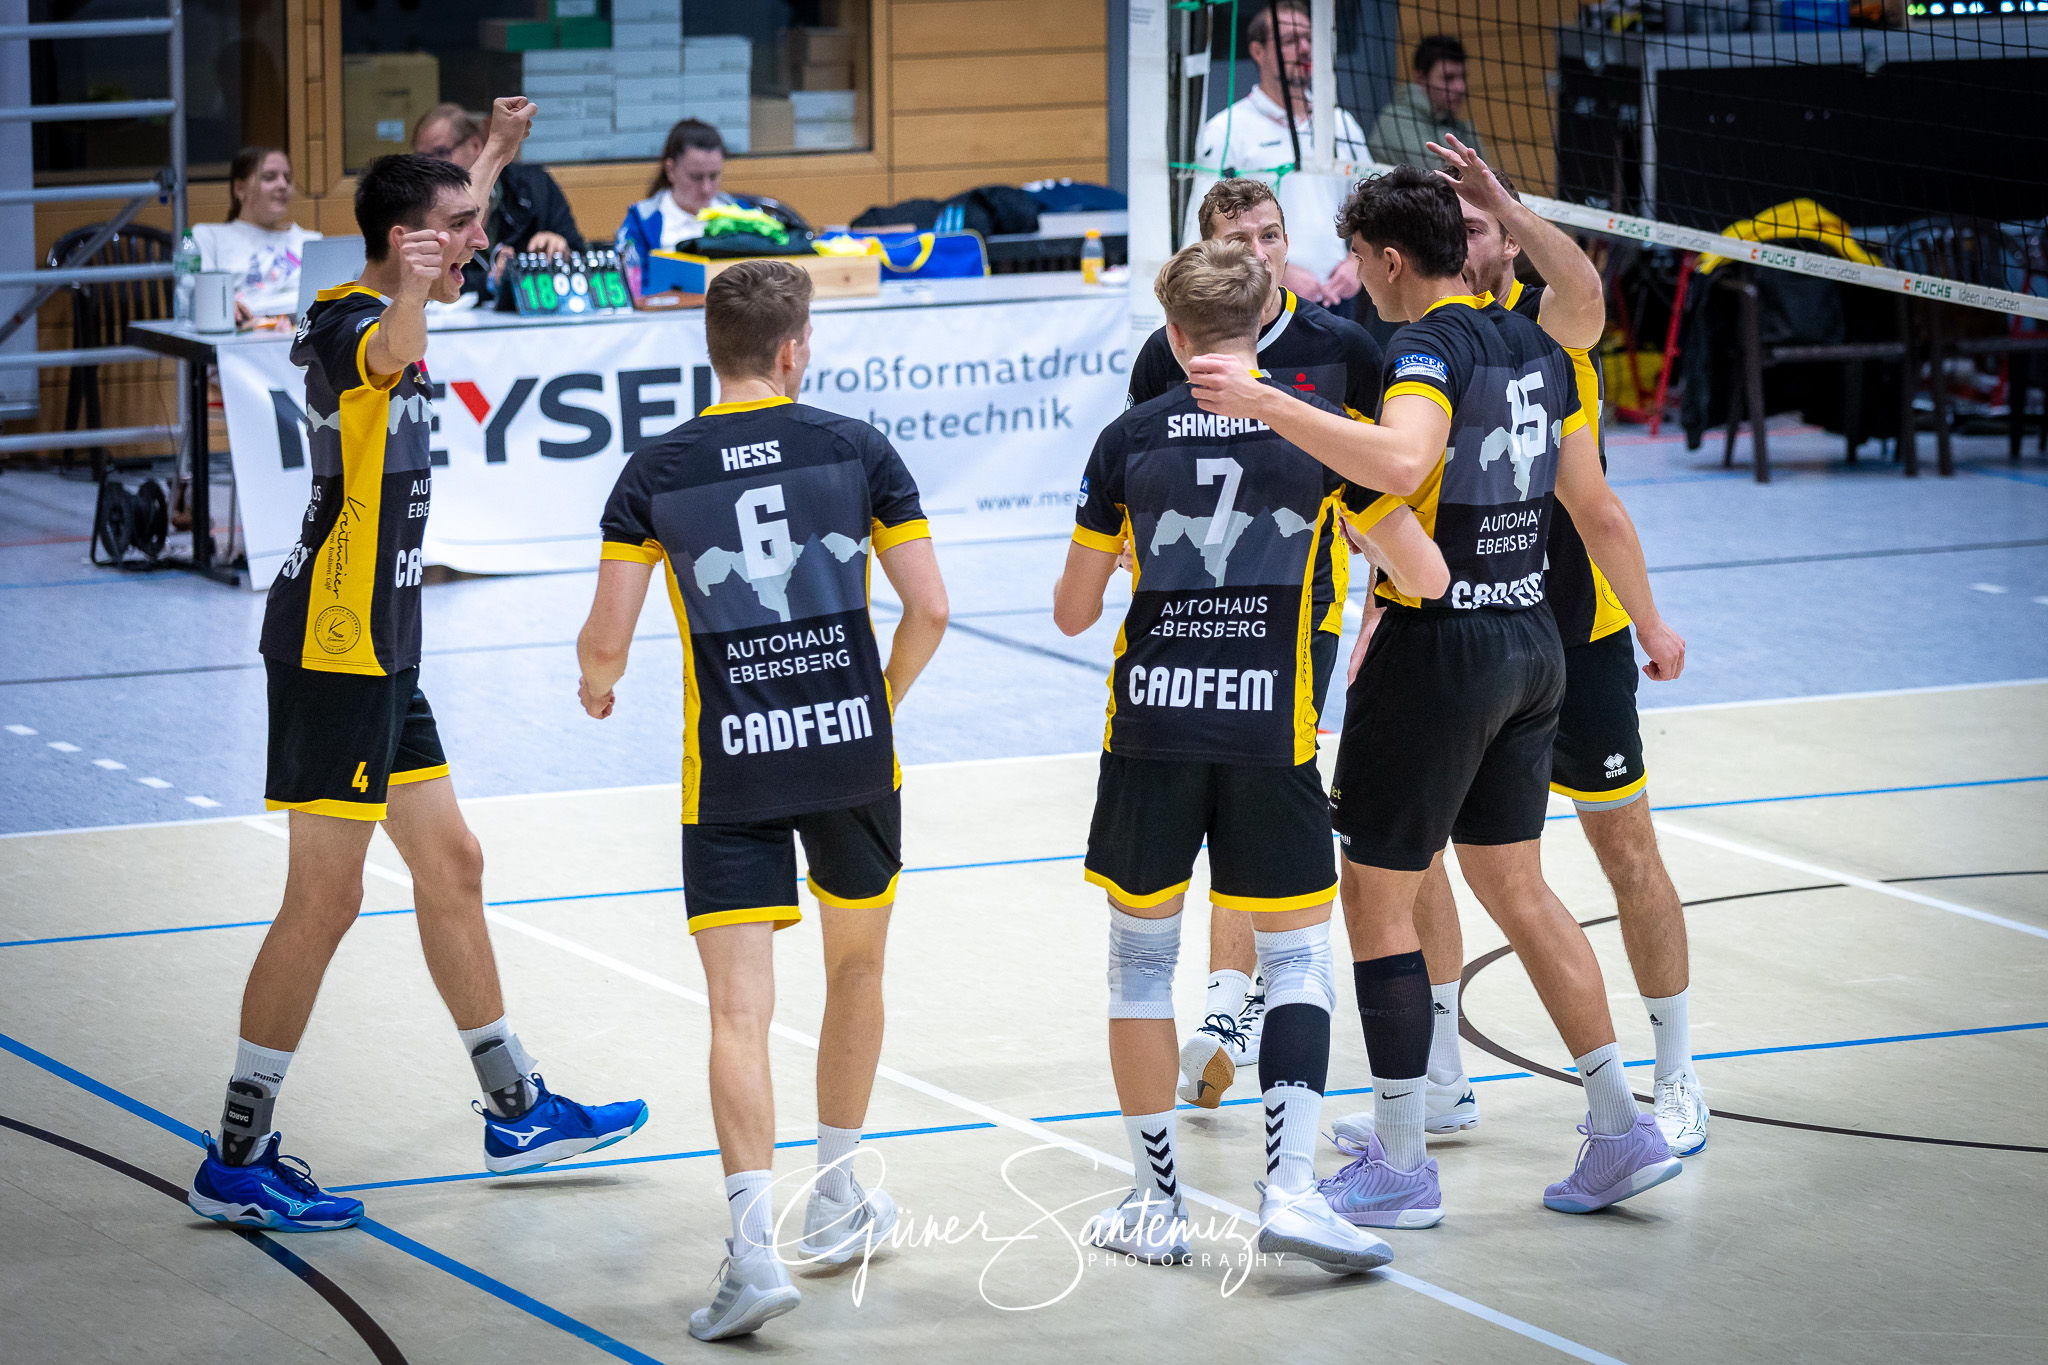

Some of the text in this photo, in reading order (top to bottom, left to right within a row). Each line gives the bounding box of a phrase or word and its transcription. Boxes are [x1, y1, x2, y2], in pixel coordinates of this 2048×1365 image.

[1617, 220, 1650, 237] FUCHS
[1760, 250, 1796, 267] FUCHS
[521, 273, 558, 309] 18
[590, 271, 627, 307] 15
[1914, 280, 1952, 298] FUCHS
[800, 346, 1128, 394] roßformatdruc
[269, 366, 712, 470] YSE
[868, 397, 1074, 441] betechnik
[721, 440, 782, 472] HESS
[976, 489, 1078, 512] www.me
[1196, 457, 1244, 545] 7
[734, 484, 796, 580] 6
[1479, 508, 1542, 533] AUTOHA
[1160, 596, 1268, 618] AUTOHAUS
[726, 624, 846, 661] AUTOHAUS
[1150, 620, 1267, 638] EBERSBERG
[728, 649, 851, 685] EBERSBERG
[351, 761, 369, 793] 4
